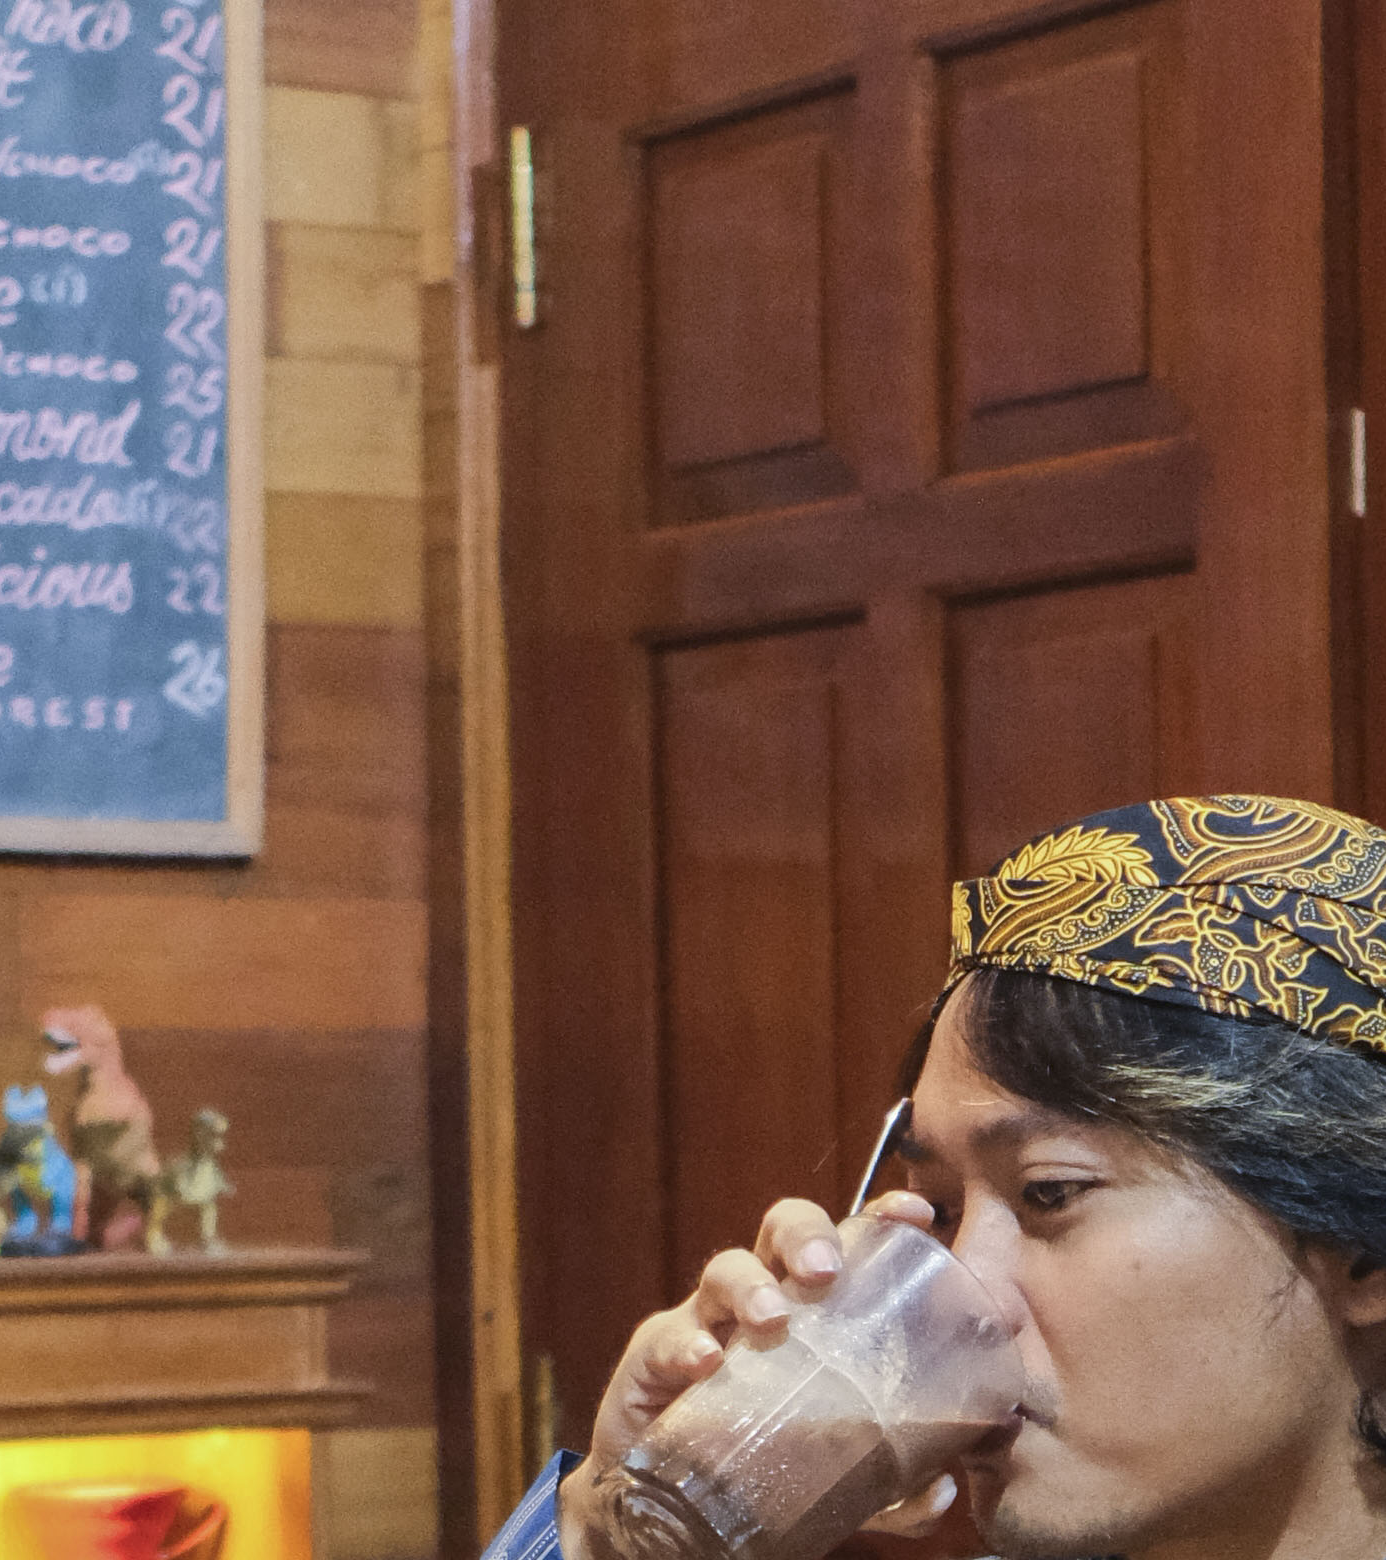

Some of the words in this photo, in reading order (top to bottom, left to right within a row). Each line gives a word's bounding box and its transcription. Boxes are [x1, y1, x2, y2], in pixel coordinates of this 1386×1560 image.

[154, 7, 224, 75] 21
[160, 73, 225, 148] 21
[161, 150, 223, 216] 21
[160, 217, 222, 279] 21
[163, 420, 221, 479] 21
